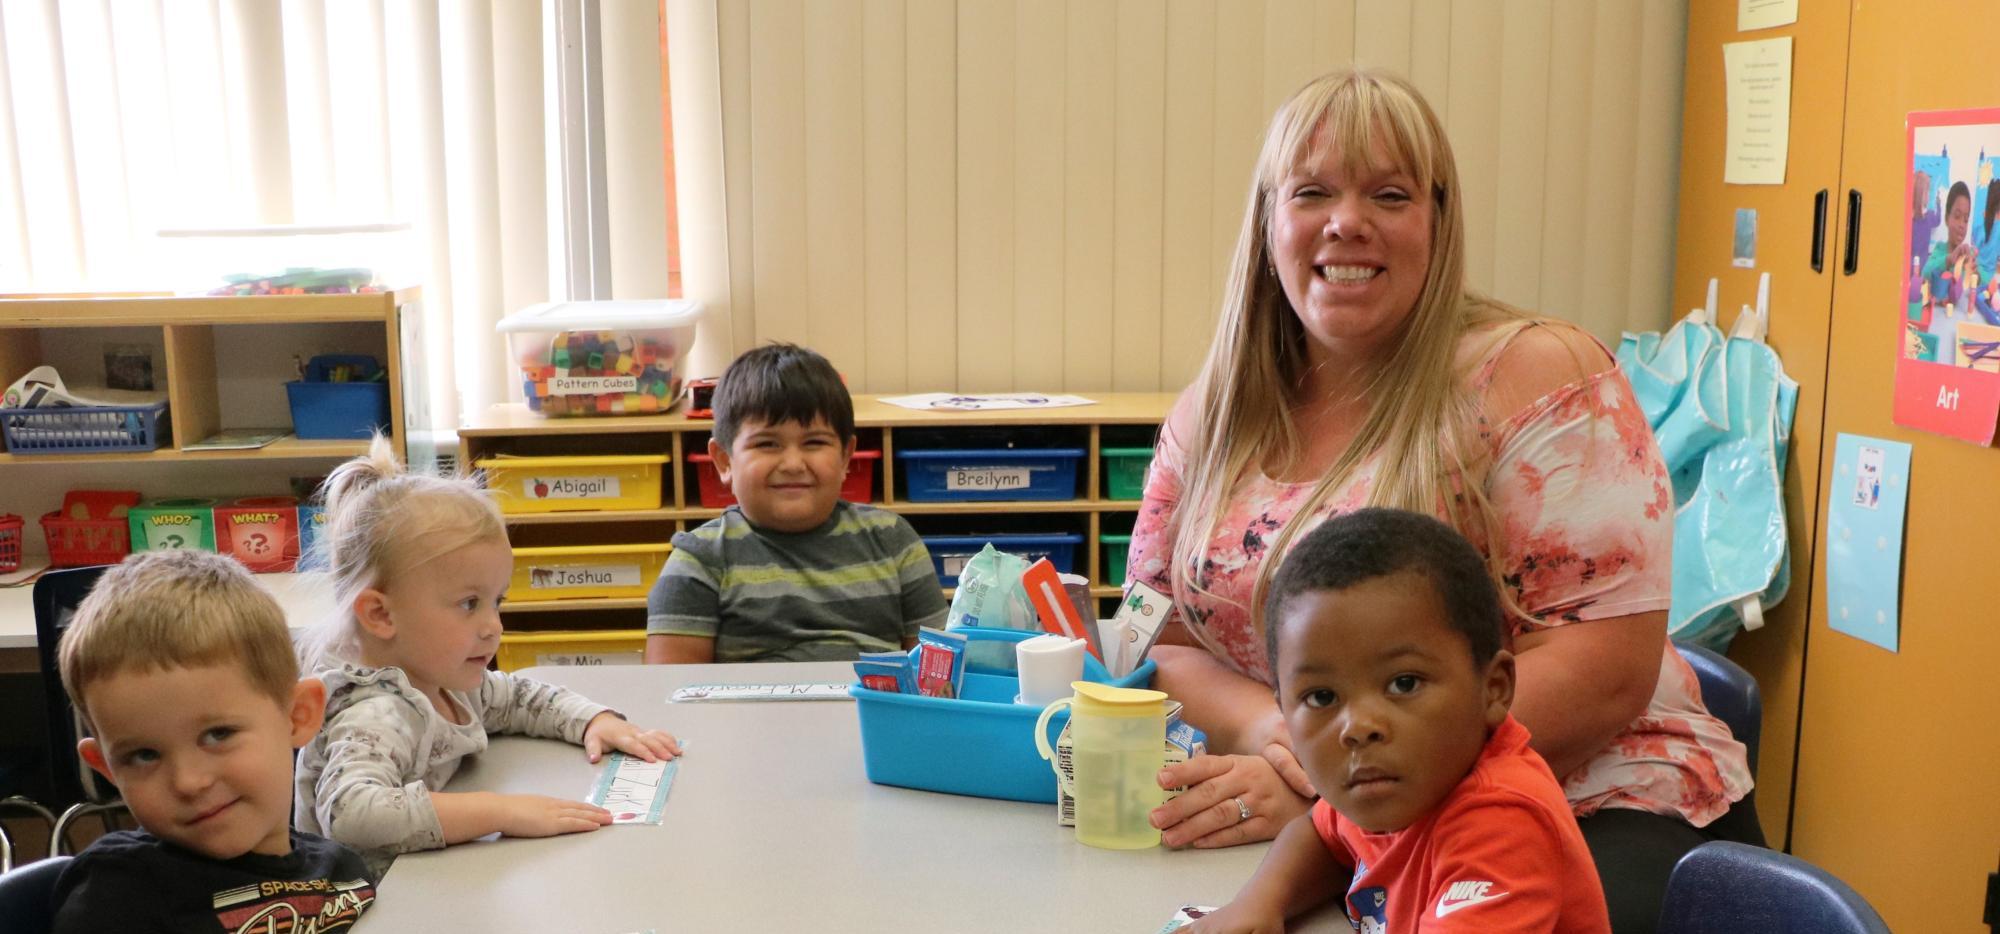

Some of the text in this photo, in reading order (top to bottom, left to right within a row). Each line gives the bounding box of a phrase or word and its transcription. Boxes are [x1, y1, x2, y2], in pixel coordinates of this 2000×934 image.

[556, 378, 634, 389] Pattern Cubes
[1935, 384, 1959, 411] Art
[552, 478, 606, 497] Abigail
[957, 471, 1020, 489] Breilynn
[151, 514, 193, 526] WHO?
[231, 512, 281, 525] WHAT?
[556, 569, 612, 585] Joshua
[260, 880, 313, 896] SPACE
[1444, 880, 1493, 901] NIKE
